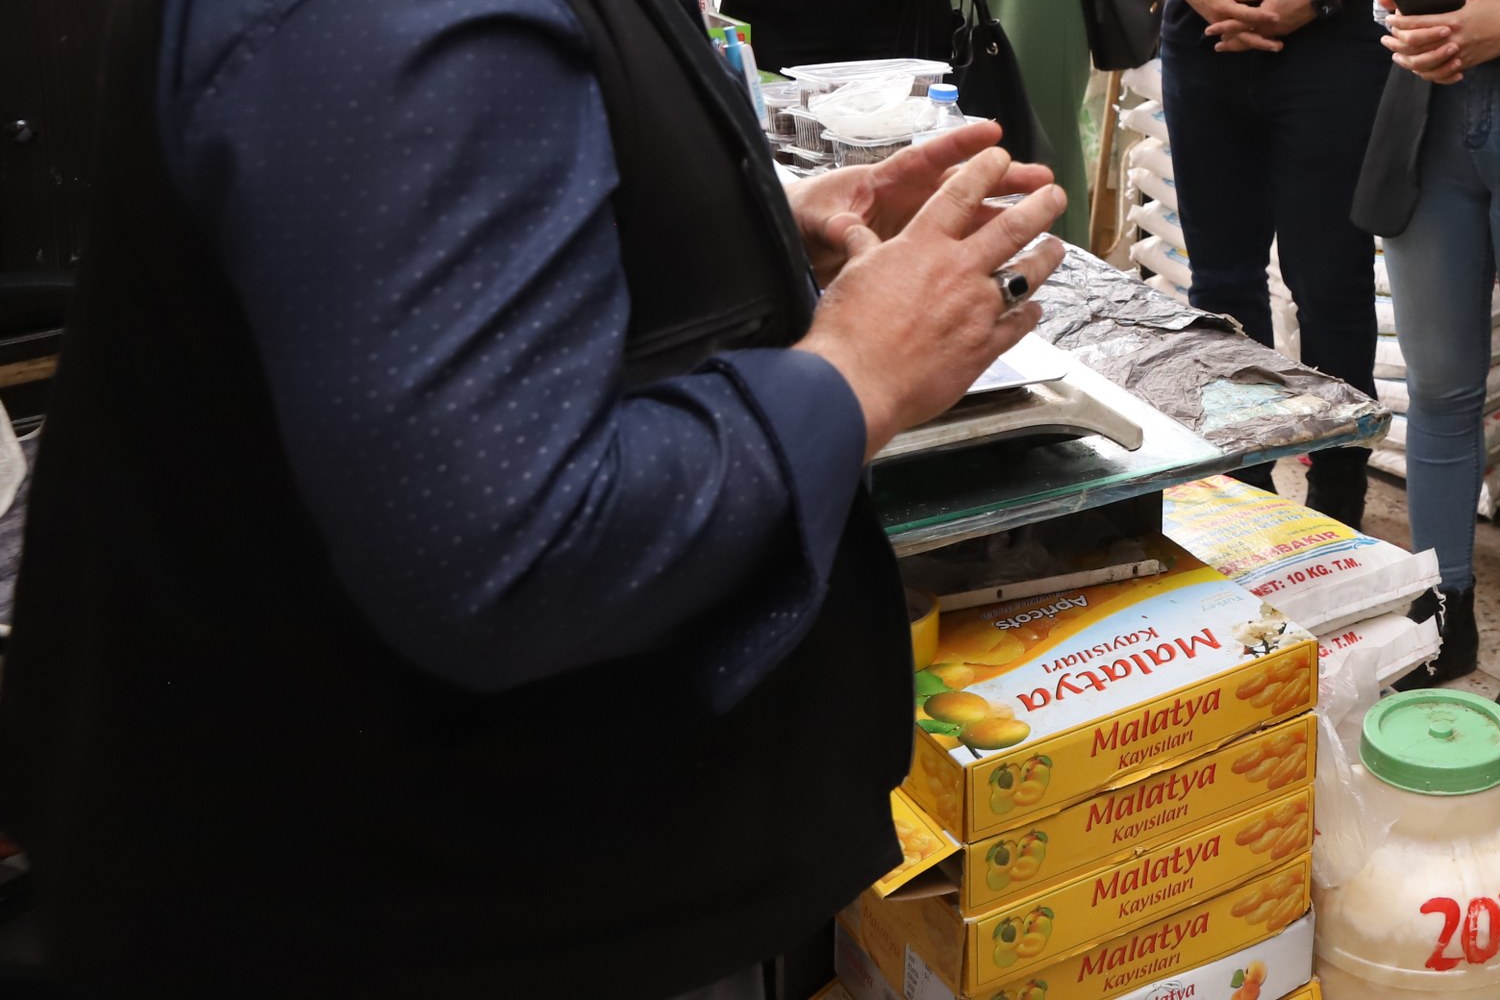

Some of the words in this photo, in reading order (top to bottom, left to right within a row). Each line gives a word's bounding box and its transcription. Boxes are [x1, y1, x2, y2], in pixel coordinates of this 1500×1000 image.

[1287, 569, 1305, 586] 10
[1308, 563, 1332, 580] KG.
[1332, 556, 1362, 572] T.M.
[994, 594, 1088, 630] Apricots
[1041, 626, 1159, 674] Kayısıları
[1331, 631, 1363, 650] T.M.
[1016, 628, 1222, 712] Malatya
[1090, 688, 1221, 757] Malatya
[1118, 730, 1193, 770] Kayısıları
[1085, 762, 1217, 832] Malatya
[1112, 804, 1189, 843] Kayısıları
[1091, 835, 1221, 907] Malatya
[1118, 877, 1194, 919] Kayısıları
[1077, 911, 1210, 982] Malatya
[1103, 952, 1180, 991] Kayısıları
